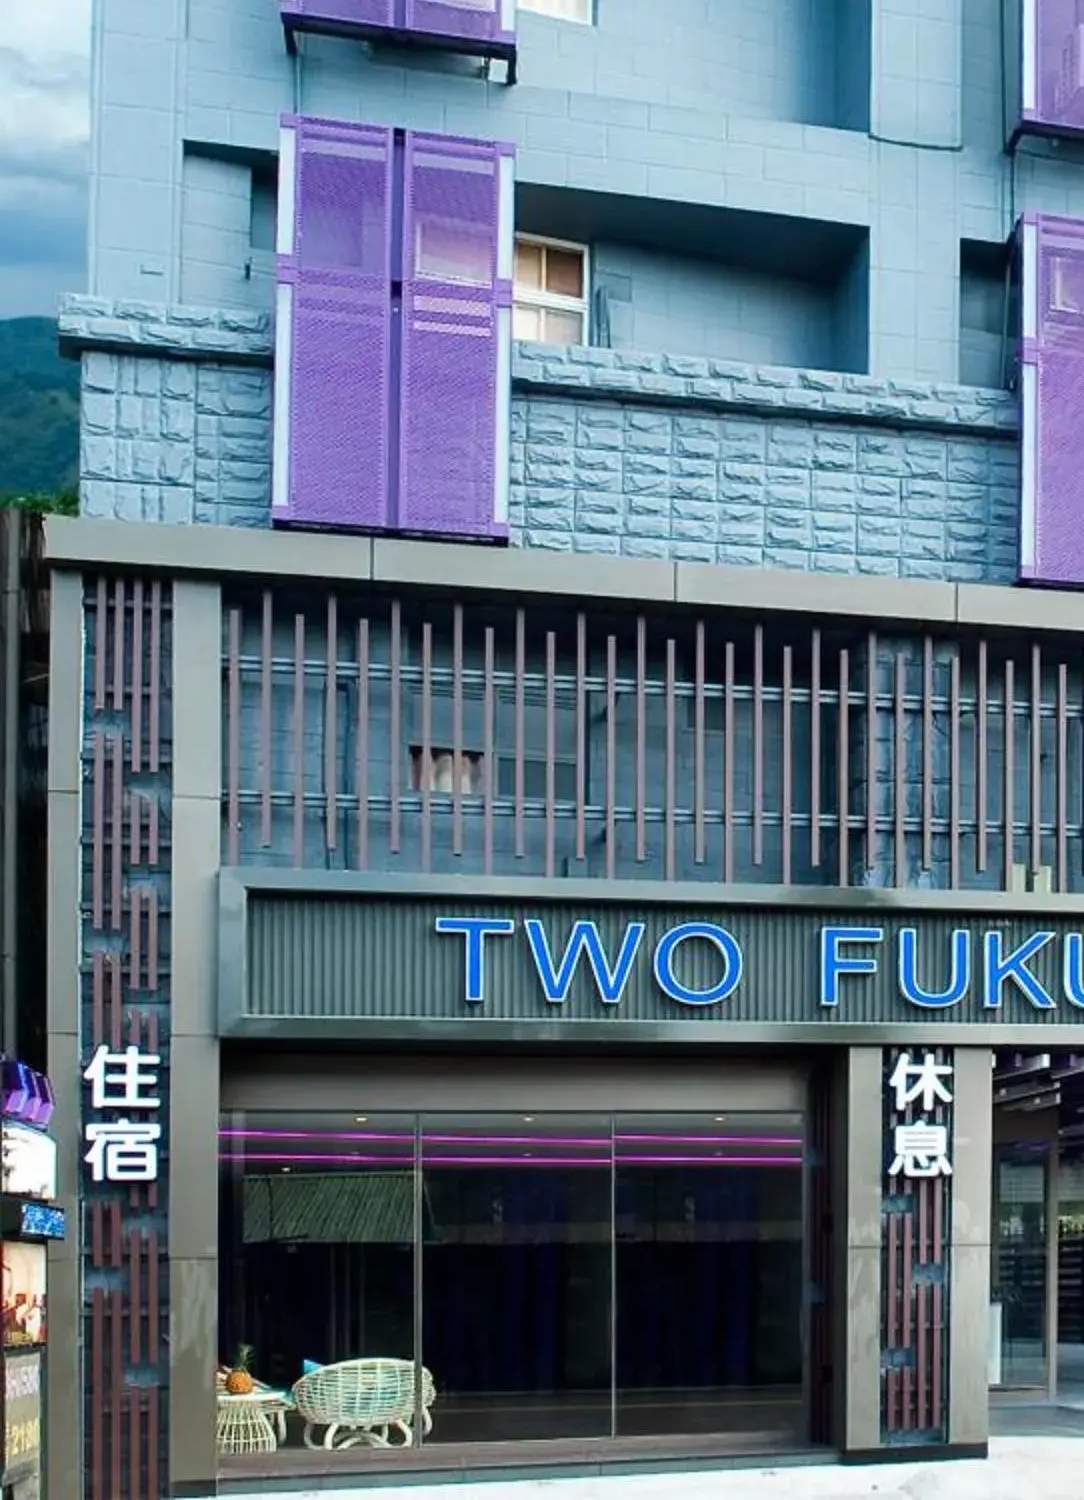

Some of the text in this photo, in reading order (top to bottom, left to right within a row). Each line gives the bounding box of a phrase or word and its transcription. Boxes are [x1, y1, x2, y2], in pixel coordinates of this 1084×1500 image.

[435, 917, 744, 1005] TWO
[83, 1044, 161, 1182] 住宿
[888, 1051, 953, 1178] 休息
